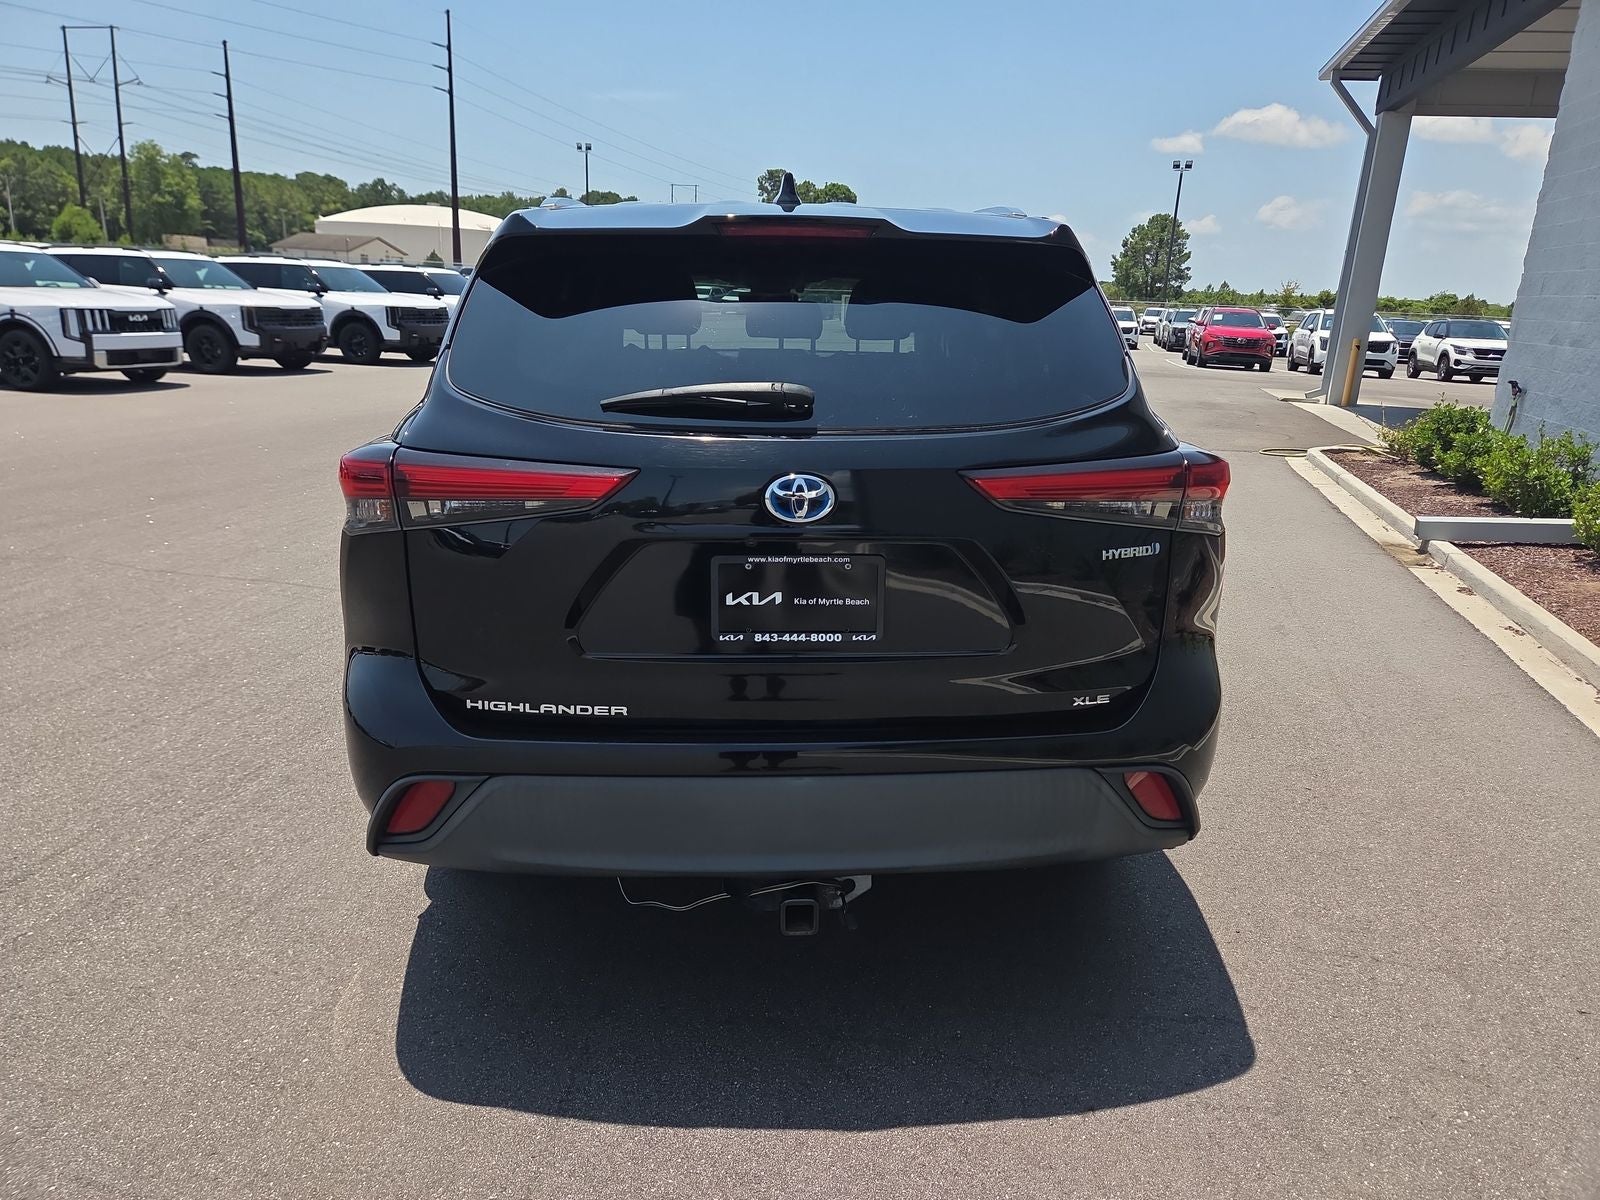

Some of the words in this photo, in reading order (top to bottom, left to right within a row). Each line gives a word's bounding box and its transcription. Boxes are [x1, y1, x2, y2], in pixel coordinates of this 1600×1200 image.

[1102, 544, 1153, 561] HYBRID
[747, 555, 850, 564] www.kiaofmyrtlebeach.com
[794, 597, 807, 606] Kia
[808, 597, 817, 606] of
[818, 597, 844, 607] Myrtle
[845, 597, 870, 606] Beach
[754, 633, 843, 642] 843-444-8000
[1072, 694, 1110, 707] XLE
[466, 699, 628, 716] HIGHLANDER
